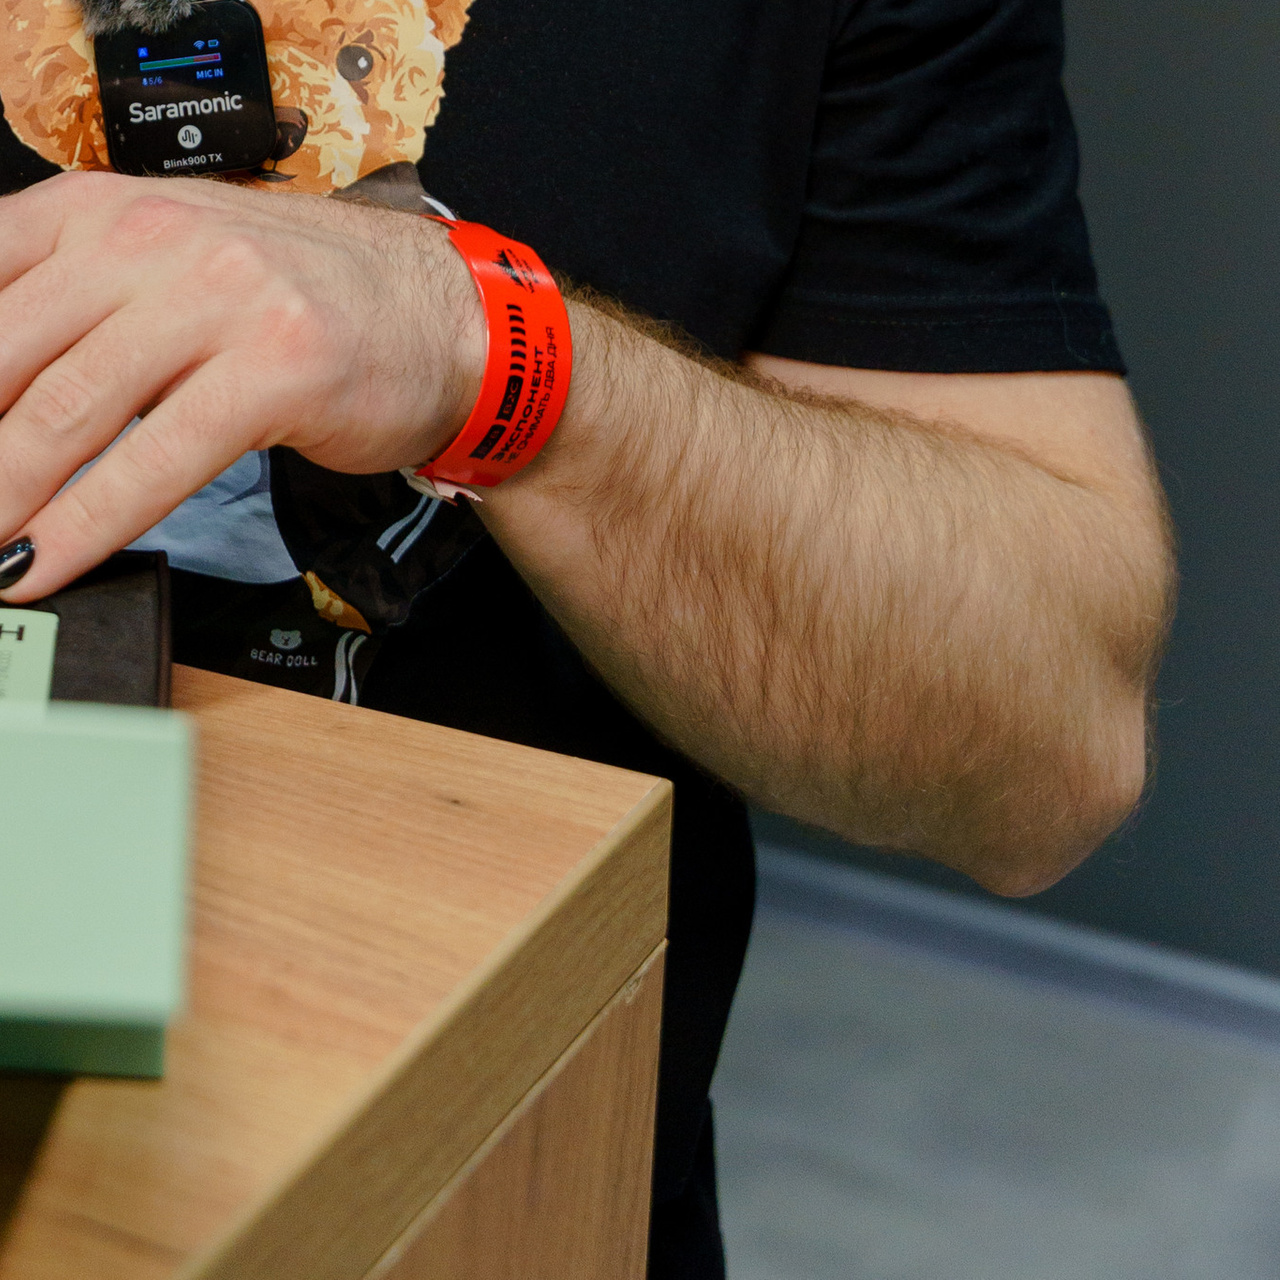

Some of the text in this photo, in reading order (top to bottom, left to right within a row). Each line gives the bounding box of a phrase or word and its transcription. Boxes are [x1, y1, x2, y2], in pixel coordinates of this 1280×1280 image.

[195, 68, 224, 79] MIC IN
[129, 90, 243, 123] Saramonic
[163, 153, 223, 169] Blink900 TX
[545, 326, 557, 358] ДНЯ
[544, 360, 556, 390] ДВА
[491, 345, 543, 462] ЭКСПОНЕНТ
[503, 380, 519, 415] B2C
[517, 393, 551, 450] СНИМАТЬ
[250, 648, 318, 667] BEAR DOLL
